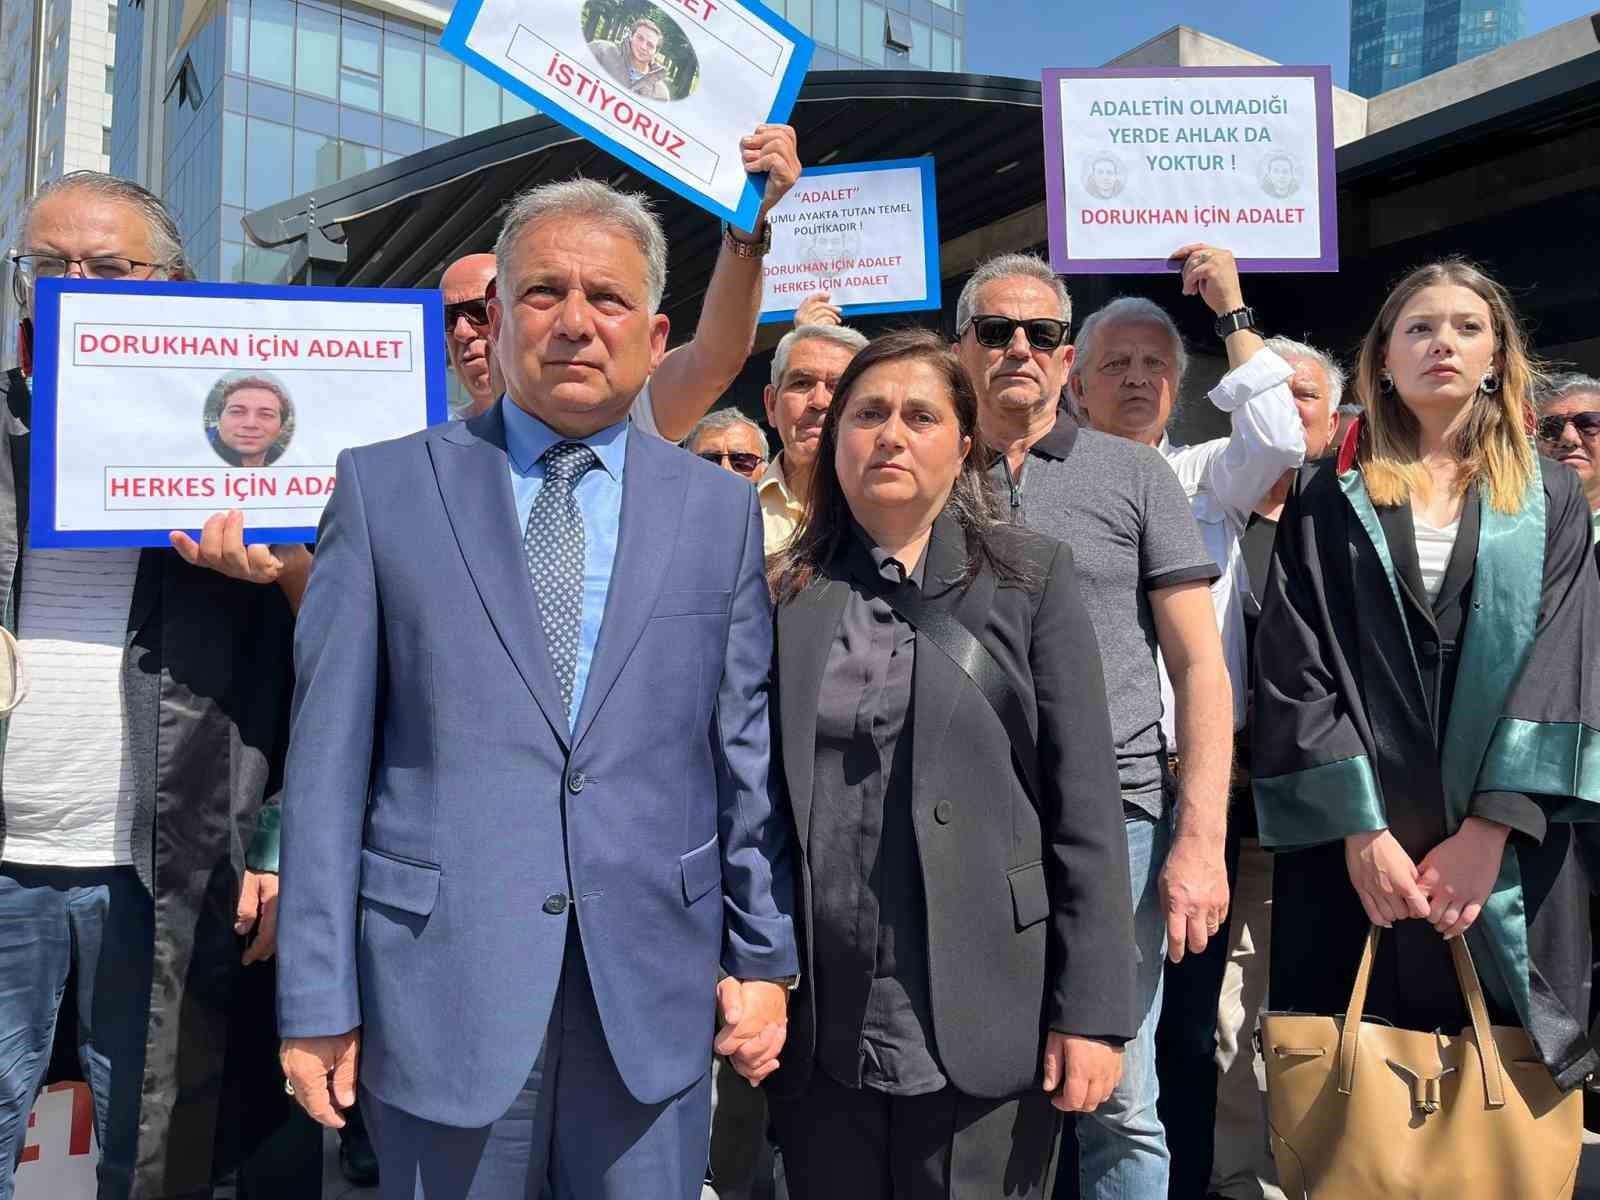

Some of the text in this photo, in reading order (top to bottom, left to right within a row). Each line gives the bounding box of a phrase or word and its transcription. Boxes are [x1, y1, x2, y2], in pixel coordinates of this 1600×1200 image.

[675, 0, 718, 20] ET
[546, 53, 688, 159] İSTİYORUZ
[1090, 95, 1288, 116] ADALETİN OLMADIĞI
[1109, 127, 1272, 144] YERDE AHLAK DA
[1147, 154, 1237, 171] YOKTUR !
[768, 203, 912, 224] UMU AYAKTA TUTAN TEMEL
[1081, 205, 1305, 227] DORUKHAN İÇİN ADALET
[794, 222, 856, 236] POLİTİKADIR
[832, 258, 855, 273] İÇİN
[858, 256, 902, 269] ADALET
[774, 275, 889, 294] HERKES İÇİN ADALET
[80, 334, 404, 361] DORUKHAN İÇİN ADALET
[110, 477, 216, 498] HERKES
[224, 474, 277, 502] İÇİN
